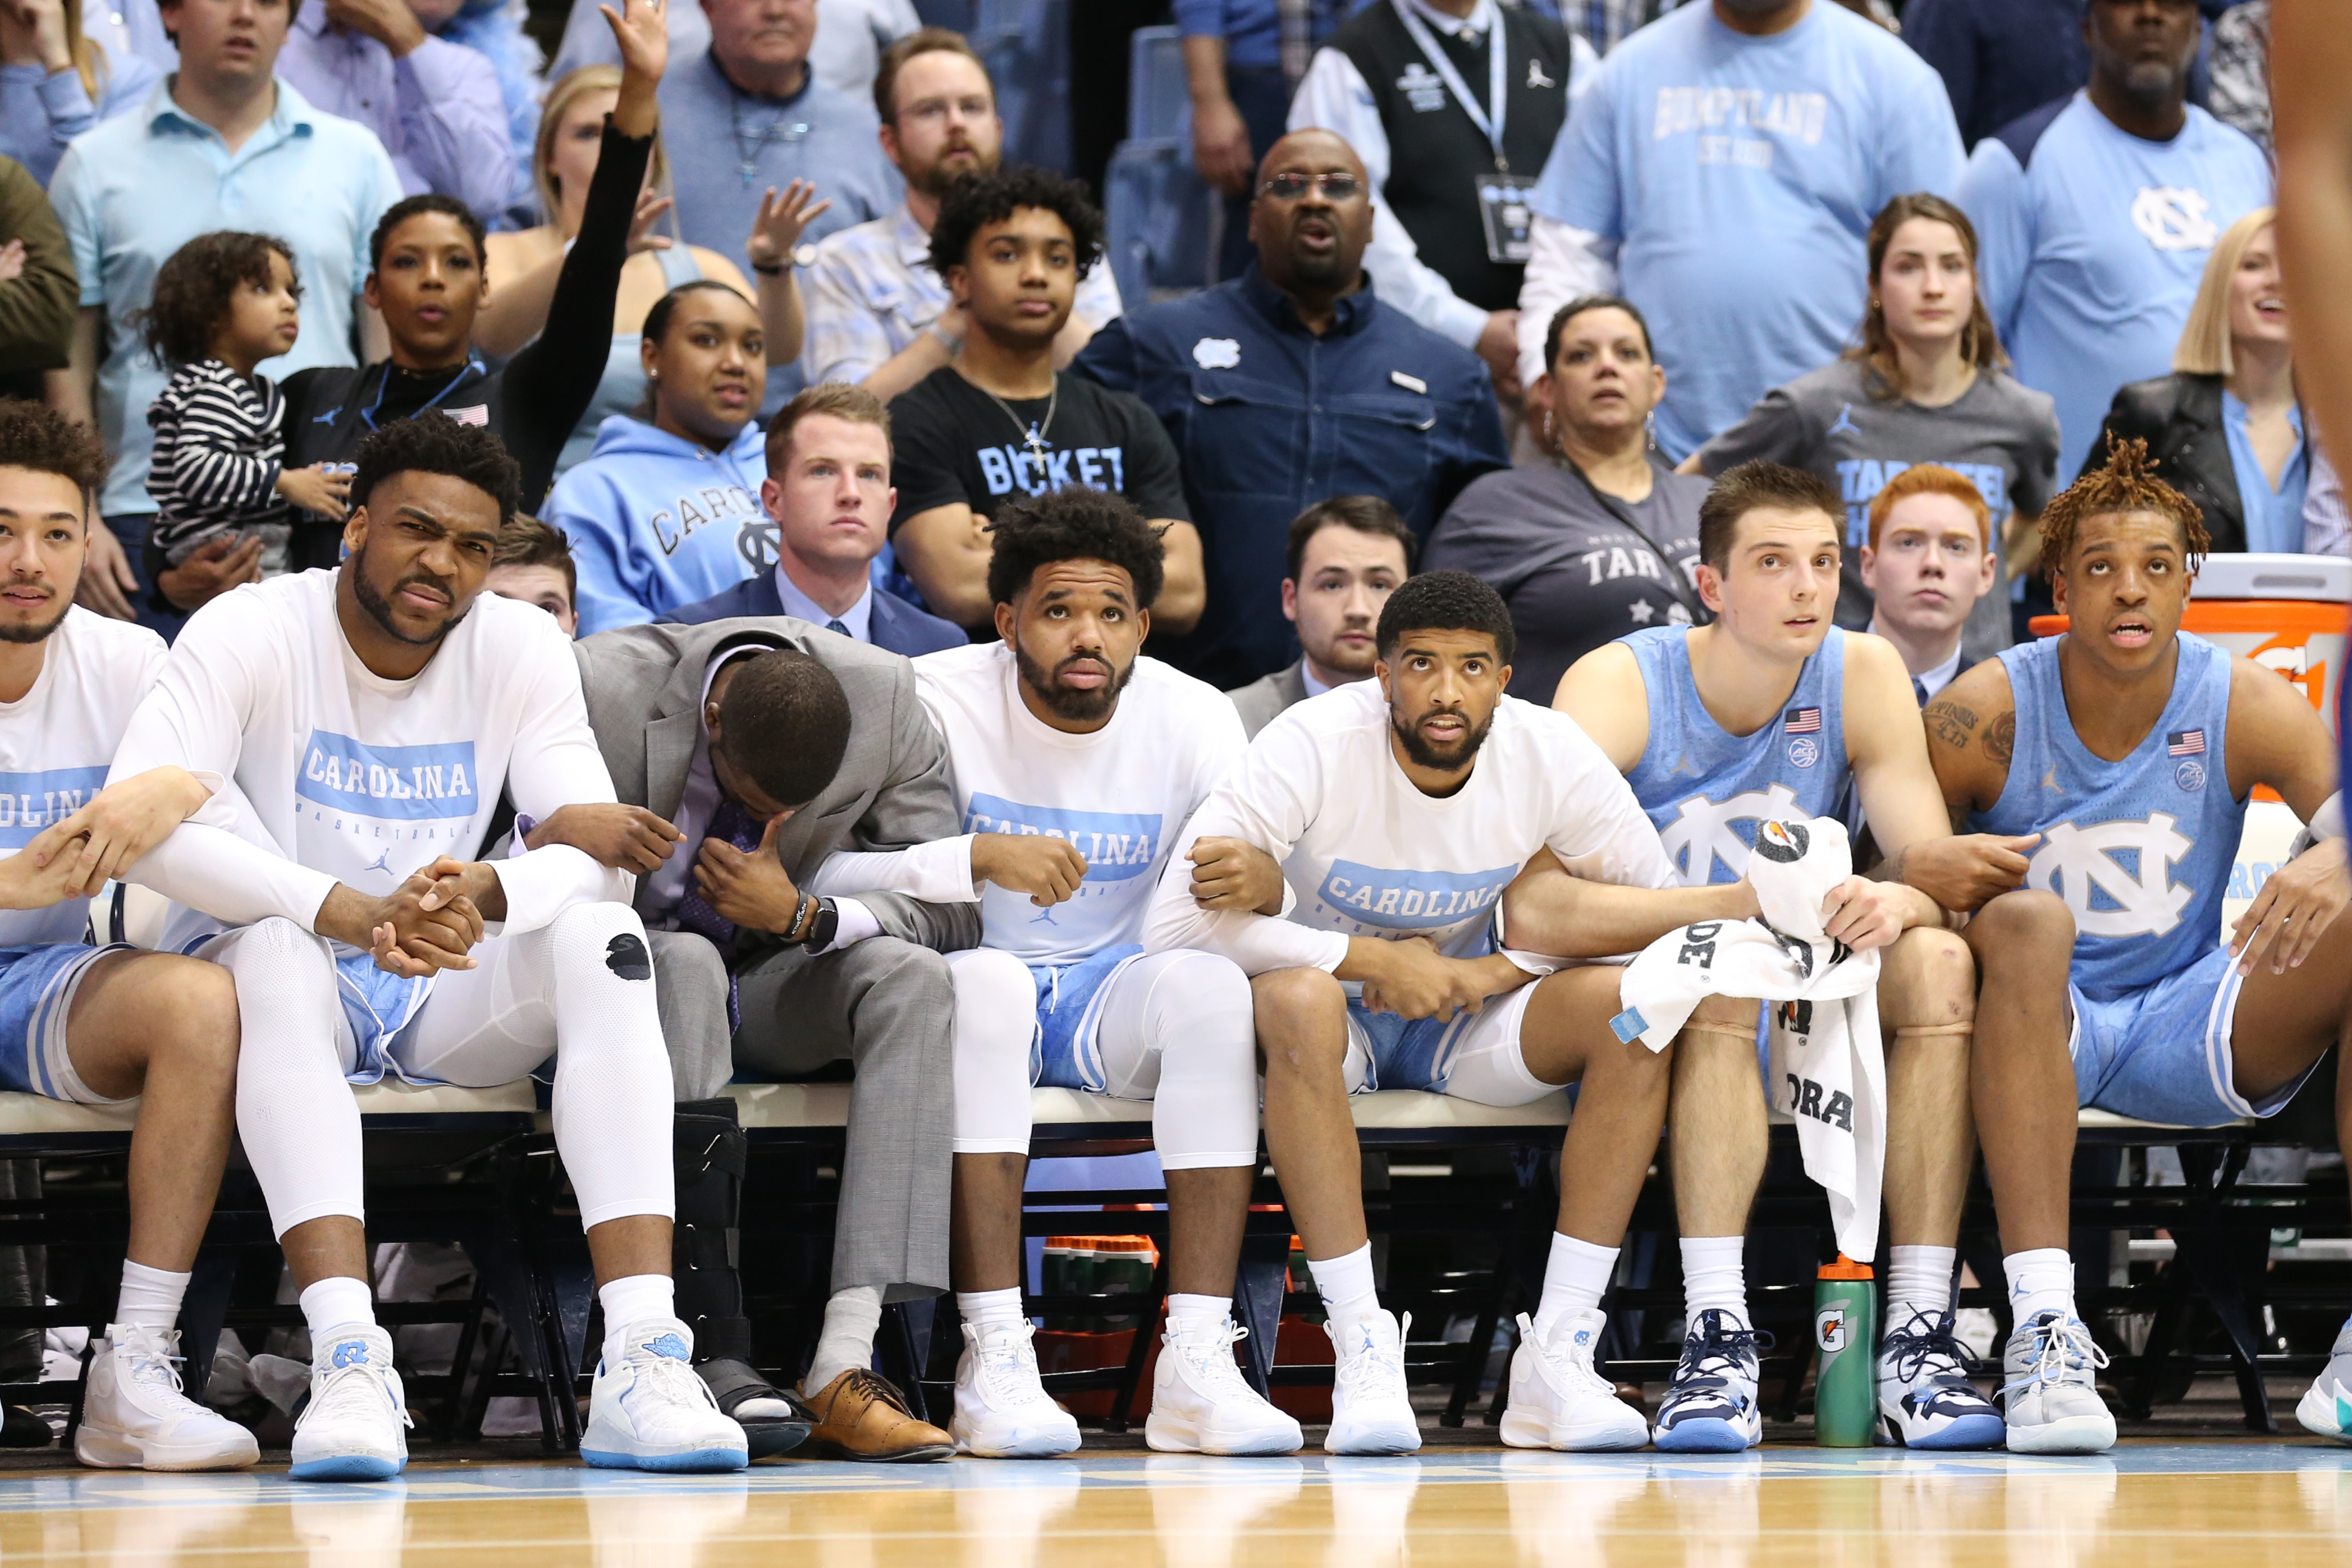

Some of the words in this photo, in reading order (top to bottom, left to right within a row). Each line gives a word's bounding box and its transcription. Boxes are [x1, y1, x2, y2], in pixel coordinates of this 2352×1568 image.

[1581, 547, 1661, 586] TAR
[306, 747, 472, 800] CAROLINA
[295, 803, 470, 840] BASKETBALL
[1328, 876, 1503, 917] CAROLINA
